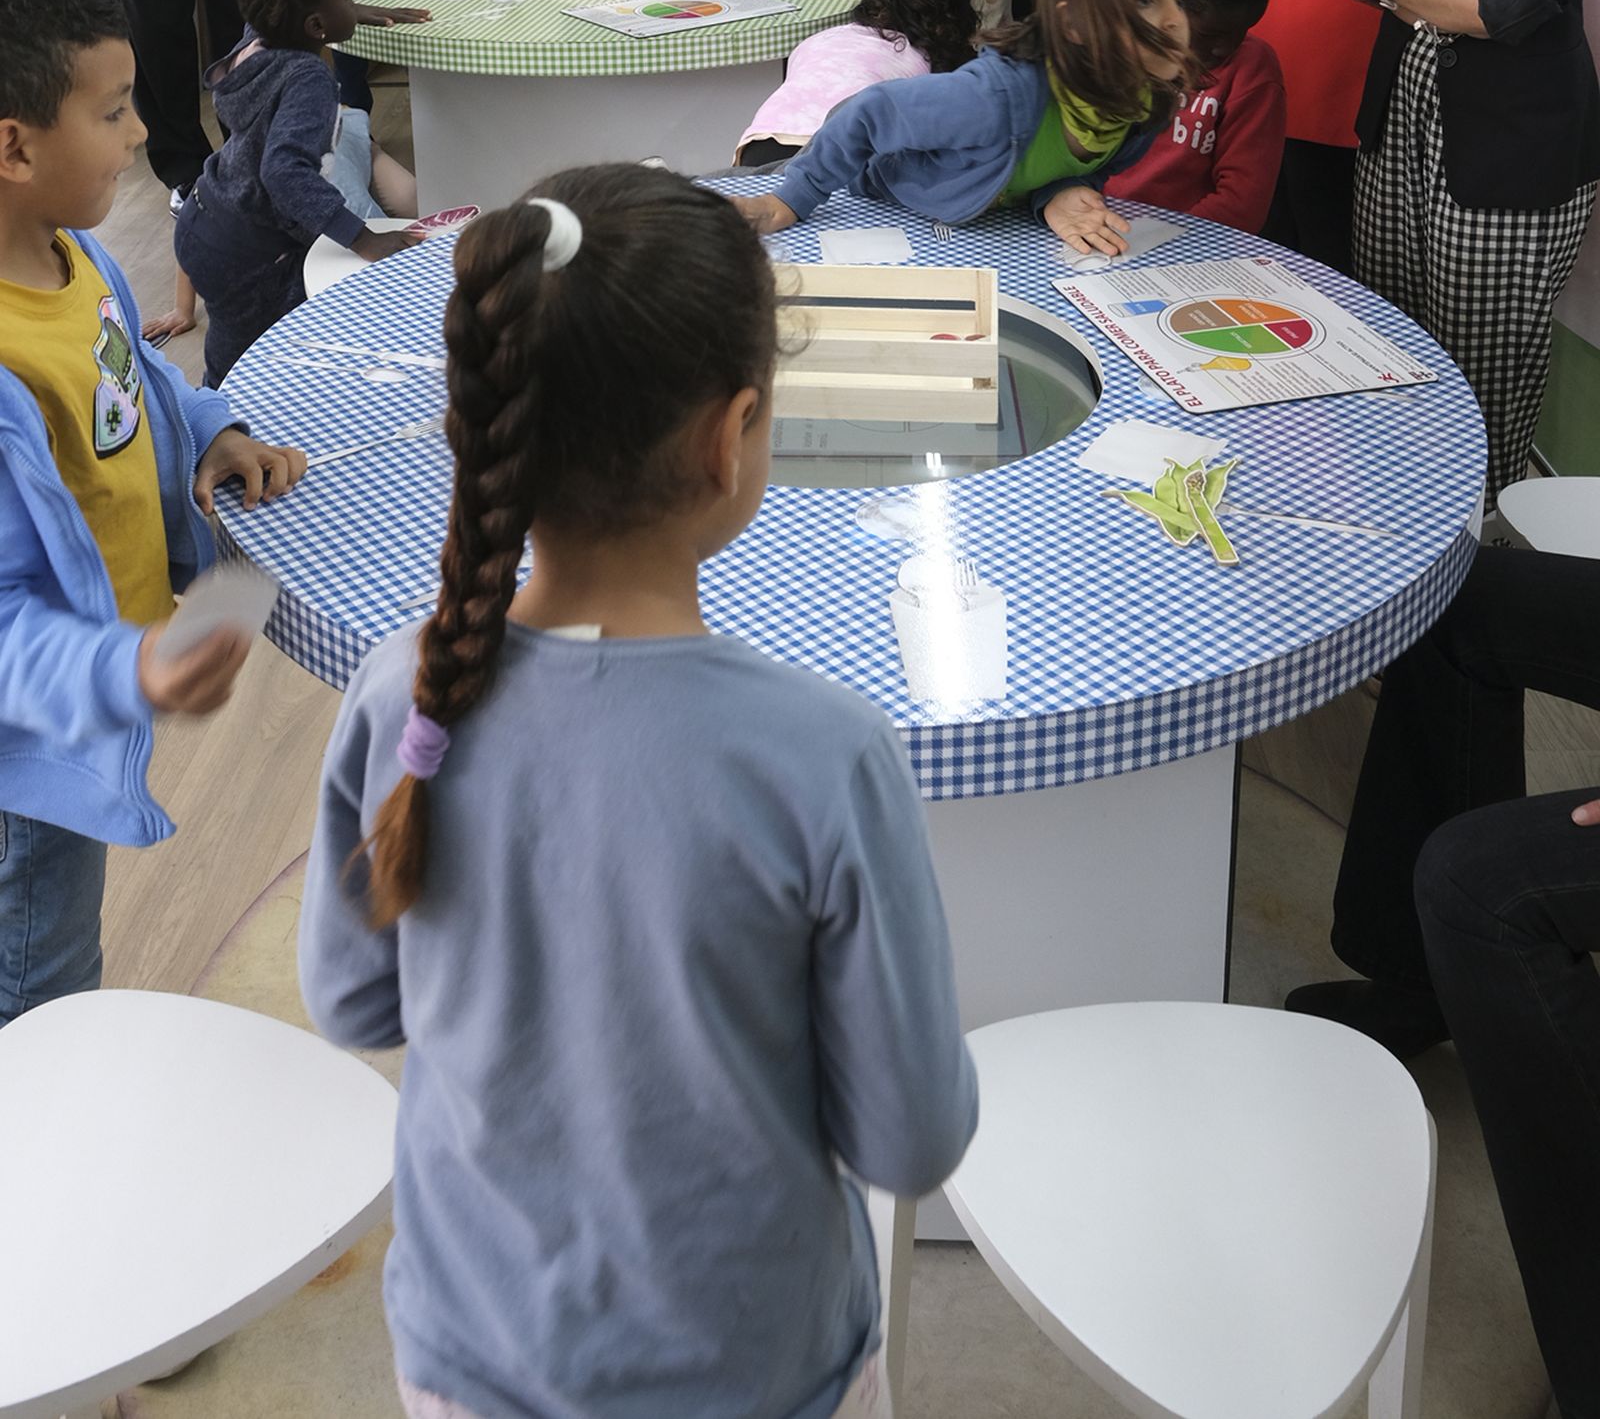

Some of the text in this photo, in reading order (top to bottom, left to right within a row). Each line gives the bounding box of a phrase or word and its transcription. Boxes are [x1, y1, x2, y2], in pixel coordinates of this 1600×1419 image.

[1173, 115, 1216, 154] big
[1063, 285, 1113, 324] SALUDABLE
[1105, 321, 1140, 350] COMER
[1133, 348, 1164, 371] PARA
[1155, 369, 1192, 398] PLATO
[1184, 396, 1203, 407] EL
